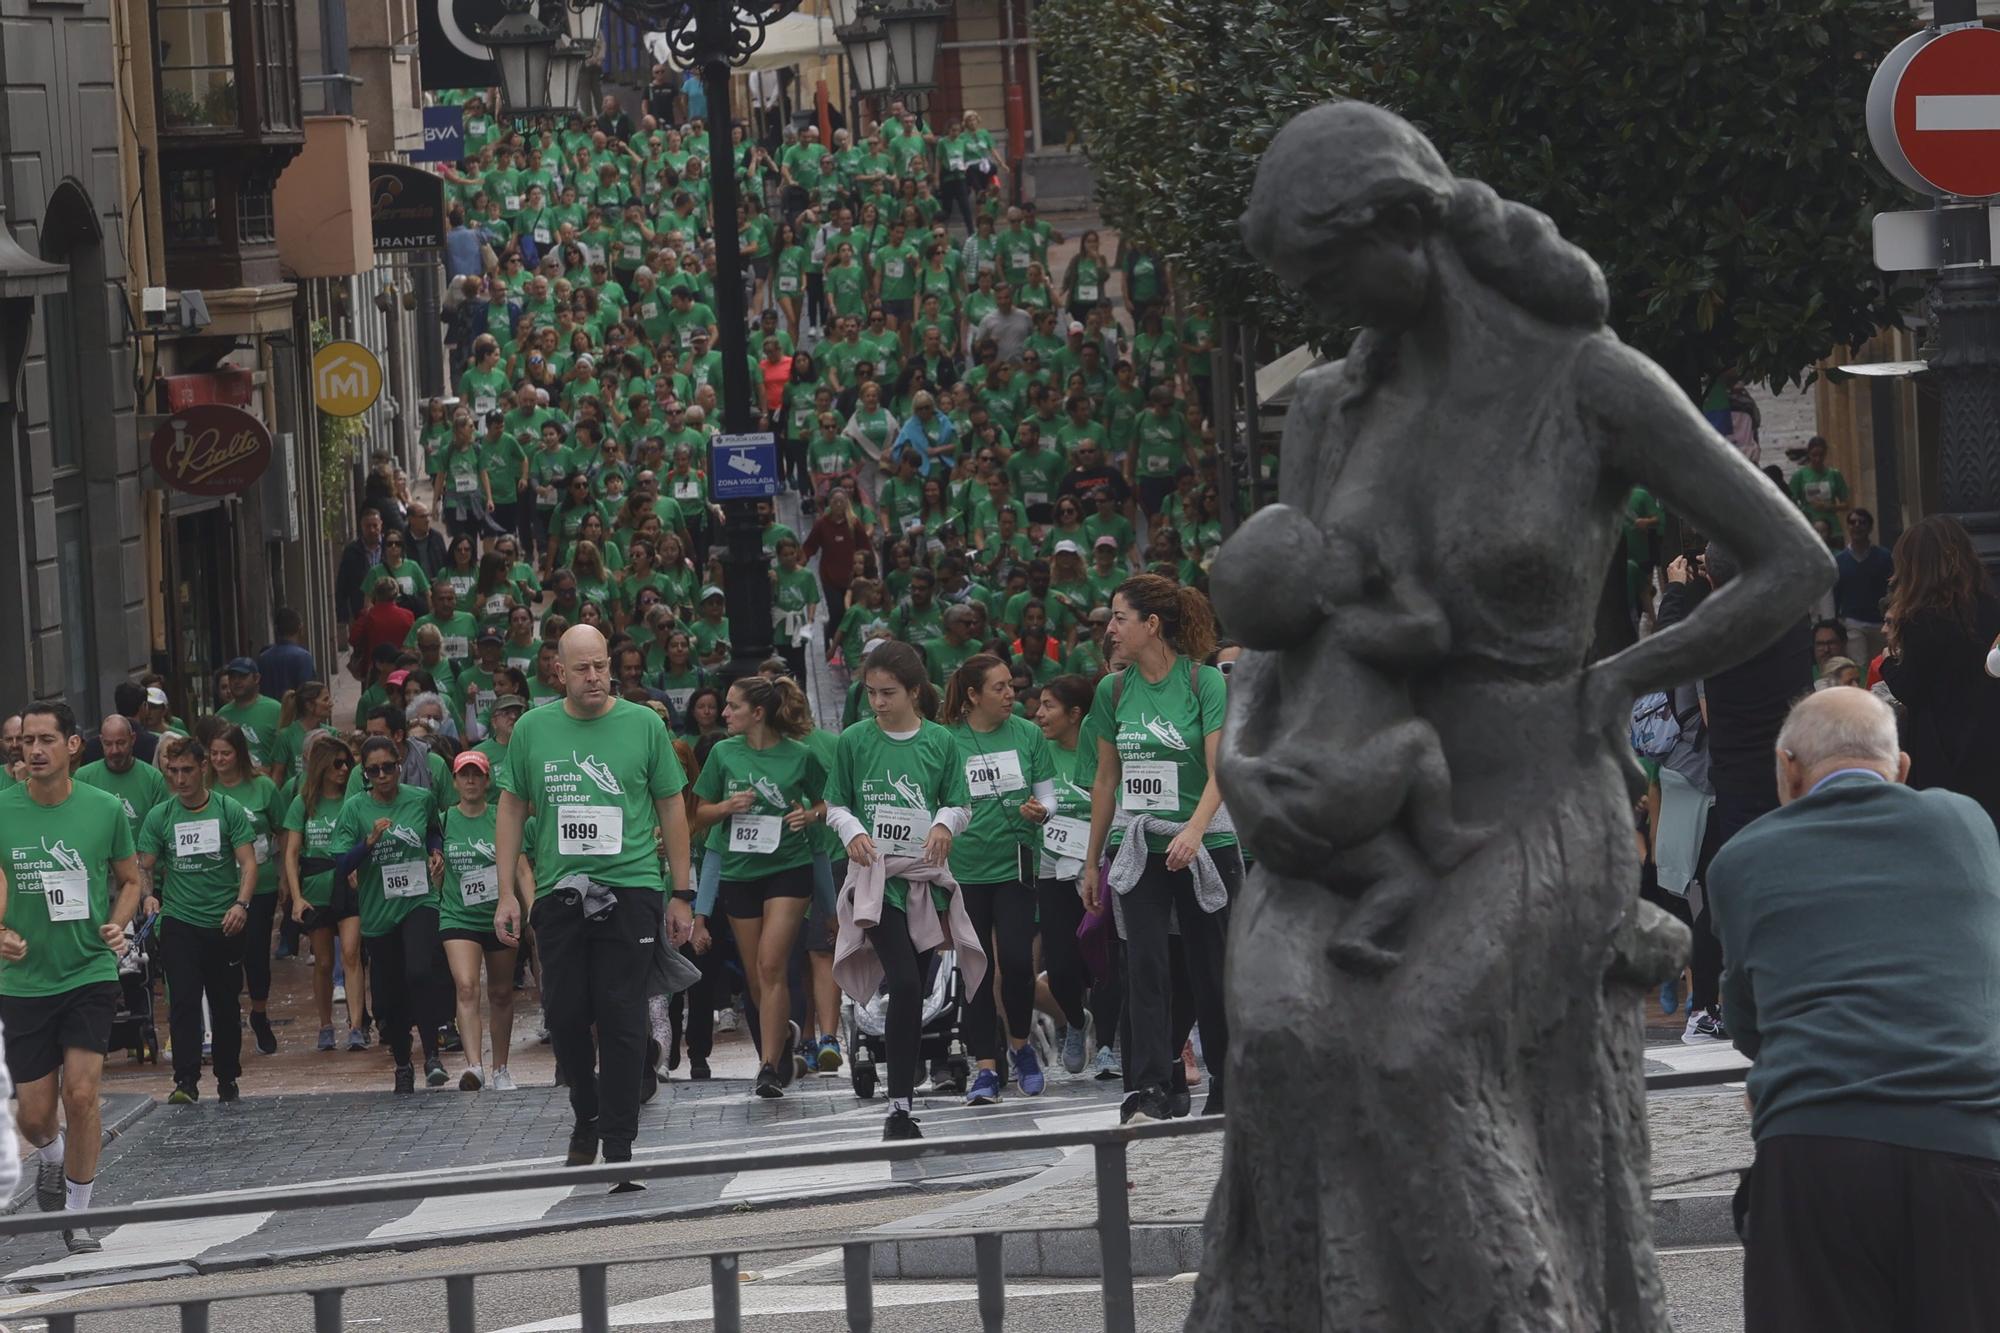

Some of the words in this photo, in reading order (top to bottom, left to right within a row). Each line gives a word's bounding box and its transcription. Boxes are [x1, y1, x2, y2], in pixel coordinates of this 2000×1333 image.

[739, 477, 774, 485] VIGILADA
[1123, 750, 1156, 760] cáncer
[544, 764, 557, 773] En
[544, 772, 582, 782] marcha
[970, 766, 1000, 783] 2081
[546, 784, 576, 792] contra
[862, 783, 873, 792] En
[1125, 778, 1162, 794] 1900
[548, 794, 554, 803] el
[556, 793, 590, 803] cáncer
[864, 792, 896, 801] marcha
[561, 823, 598, 839] 1899
[736, 828, 758, 840] 832
[876, 823, 911, 841] 1902
[1046, 827, 1068, 843] 273
[180, 833, 200, 845] 202
[12, 850, 26, 860] En
[379, 852, 403, 861] cáncer
[14, 860, 53, 869] marcha
[18, 881, 26, 890] el
[387, 876, 408, 888] 365
[465, 881, 486, 895] 225
[48, 889, 64, 905] 10
